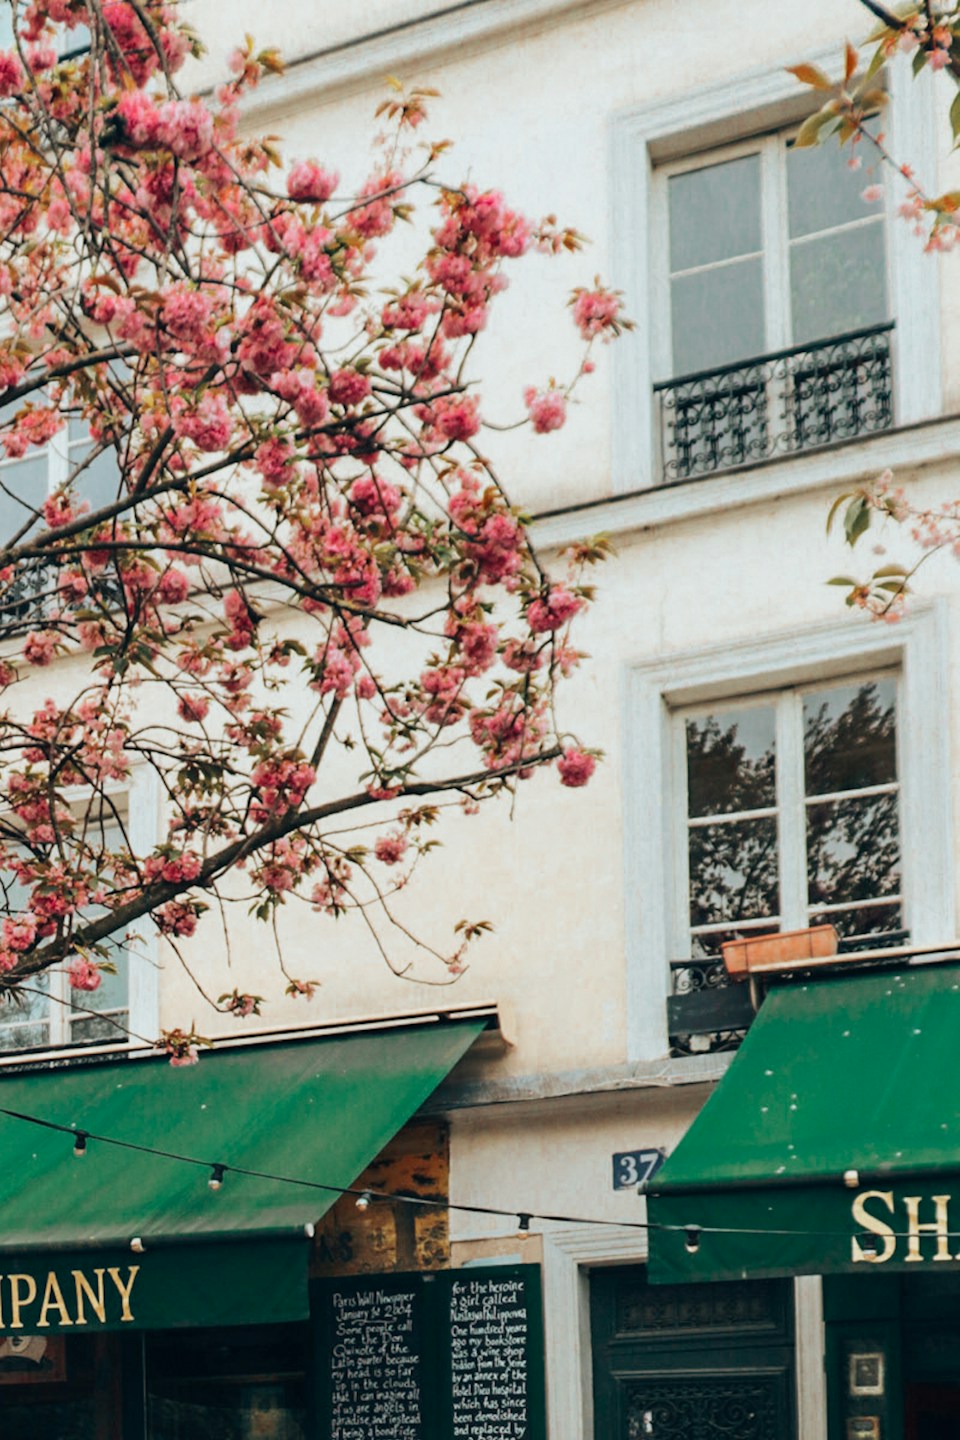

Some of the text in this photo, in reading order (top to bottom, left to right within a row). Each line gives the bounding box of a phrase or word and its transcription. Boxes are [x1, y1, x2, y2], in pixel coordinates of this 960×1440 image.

[619, 1152, 658, 1186] 37
[852, 1190, 960, 1263] SH
[452, 1280, 524, 1296] for the heroine
[333, 1292, 374, 1307] Paris Wall
[450, 1292, 517, 1310] a girl called
[384, 1304, 413, 1318] 2004
[336, 1320, 413, 1339] Some people call
[451, 1322, 527, 1337] One hundred years
[344, 1332, 403, 1345] me the Don
[469, 1339, 482, 1348] my
[485, 1335, 526, 1346] bookstore
[333, 1343, 409, 1358] Quixote of the
[452, 1349, 468, 1359] was
[481, 1346, 500, 1356] wine
[503, 1345, 525, 1359] shop
[332, 1353, 419, 1369] Latin because
[331, 1364, 414, 1380] my head is so far
[452, 1368, 526, 1383] by an annex of the
[351, 1381, 359, 1390] in
[363, 1379, 379, 1390] the
[383, 1378, 416, 1389] clouds
[492, 1381, 526, 1396] hospital
[332, 1391, 349, 1404] that
[360, 1393, 374, 1401] can
[407, 1388, 420, 1400] all
[453, 1396, 526, 1409] which has since
[332, 1401, 418, 1416] of us are angels in
[453, 1408, 526, 1423] been demolished
[389, 1413, 421, 1425] instead
[331, 1427, 341, 1440] of
[454, 1422, 526, 1438] and replaced by
